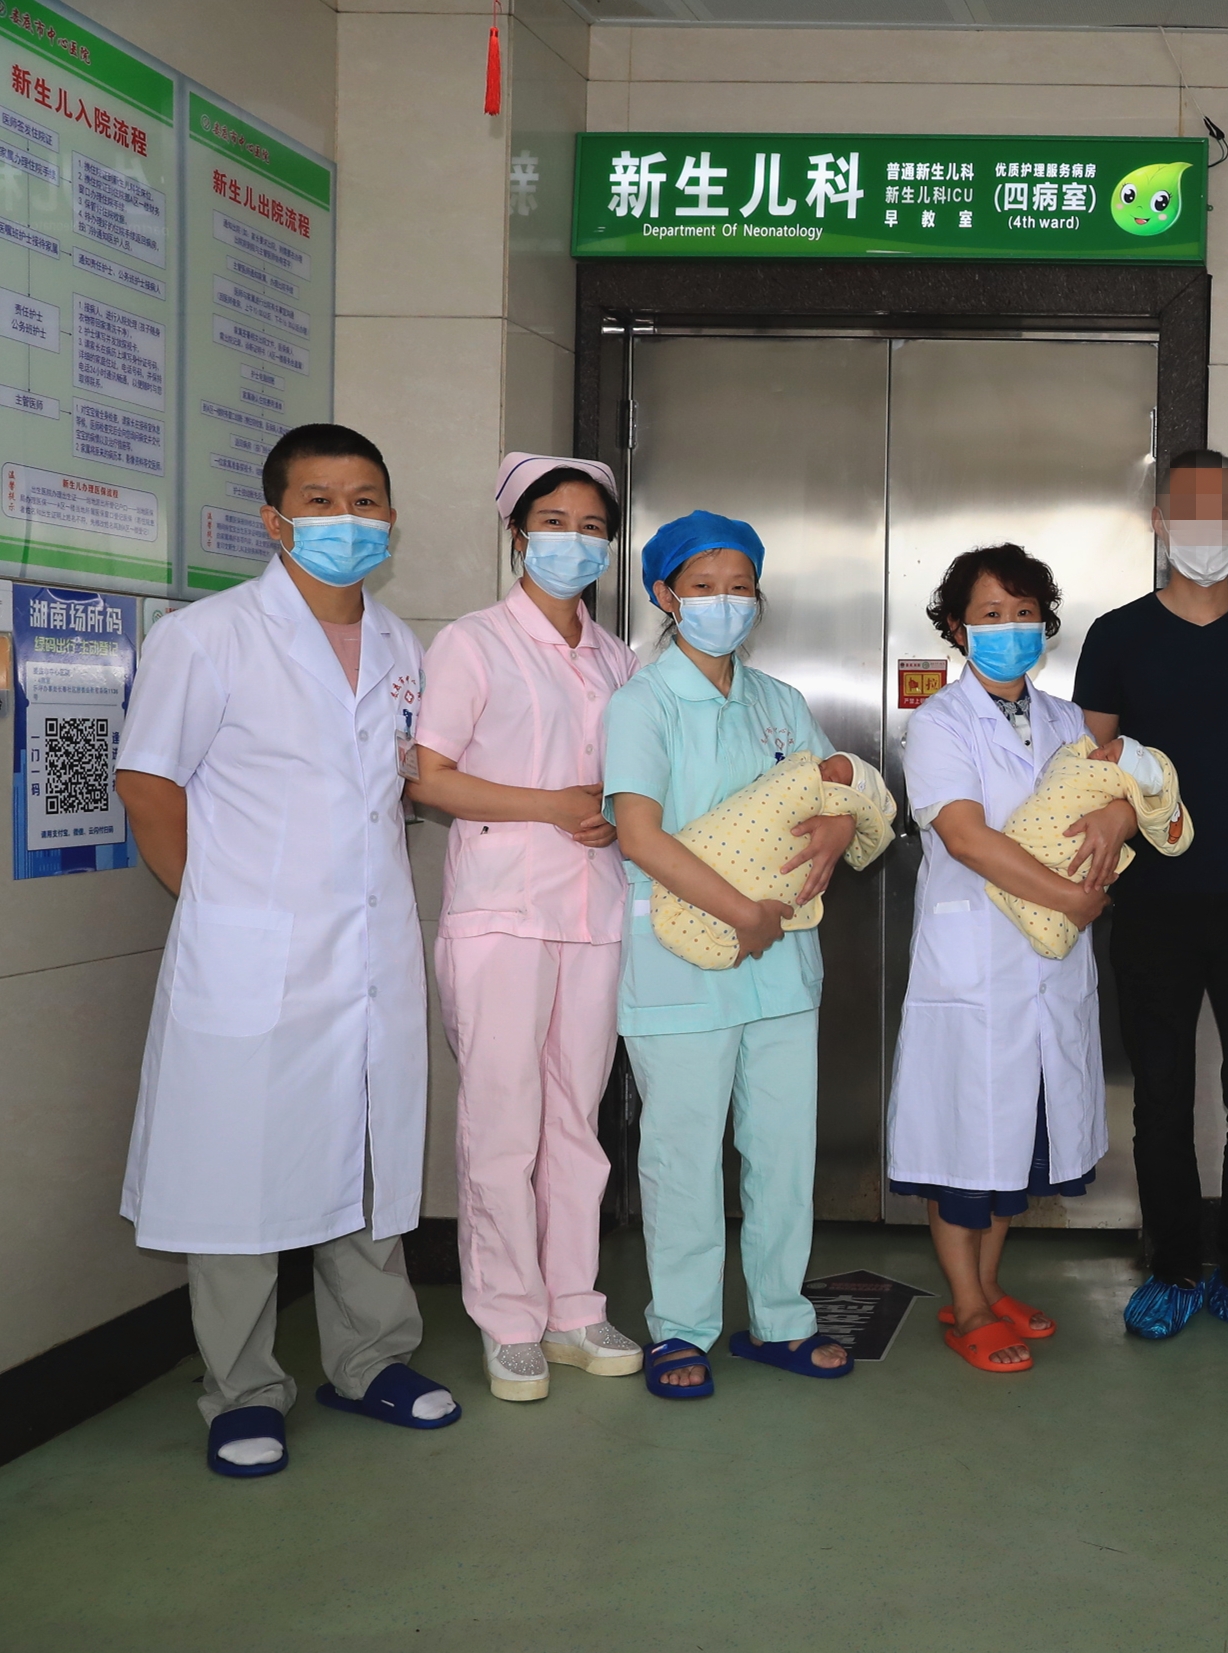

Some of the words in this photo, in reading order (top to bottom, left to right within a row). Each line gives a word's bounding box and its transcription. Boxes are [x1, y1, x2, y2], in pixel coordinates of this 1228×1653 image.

[11, 64, 148, 157] 新生儿入院流程
[2, 112, 53, 146] 医师签发住院证
[886, 161, 976, 182] 普通新生儿科
[994, 162, 1098, 179] 优质护理服务病房
[608, 151, 865, 220] 新生儿科
[885, 185, 974, 205] 新生儿科ICU
[212, 169, 311, 239] 新生儿出院流程
[994, 182, 1098, 214] (四病室)
[885, 209, 974, 229] 早教室
[1007, 216, 1036, 231] (4th
[1039, 216, 1080, 231] ward)
[642, 223, 716, 240] Department
[722, 223, 738, 237] Of
[743, 224, 824, 241] Neonatology
[14, 303, 43, 323] 责任护士
[11, 318, 47, 340] 公务班护士
[14, 394, 44, 411] 主管医师
[30, 599, 123, 635] 湖南场所码
[34, 635, 77, 654] 绿码出行
[926, 678, 938, 691] 拉
[31, 734, 41, 797] 一门一码
